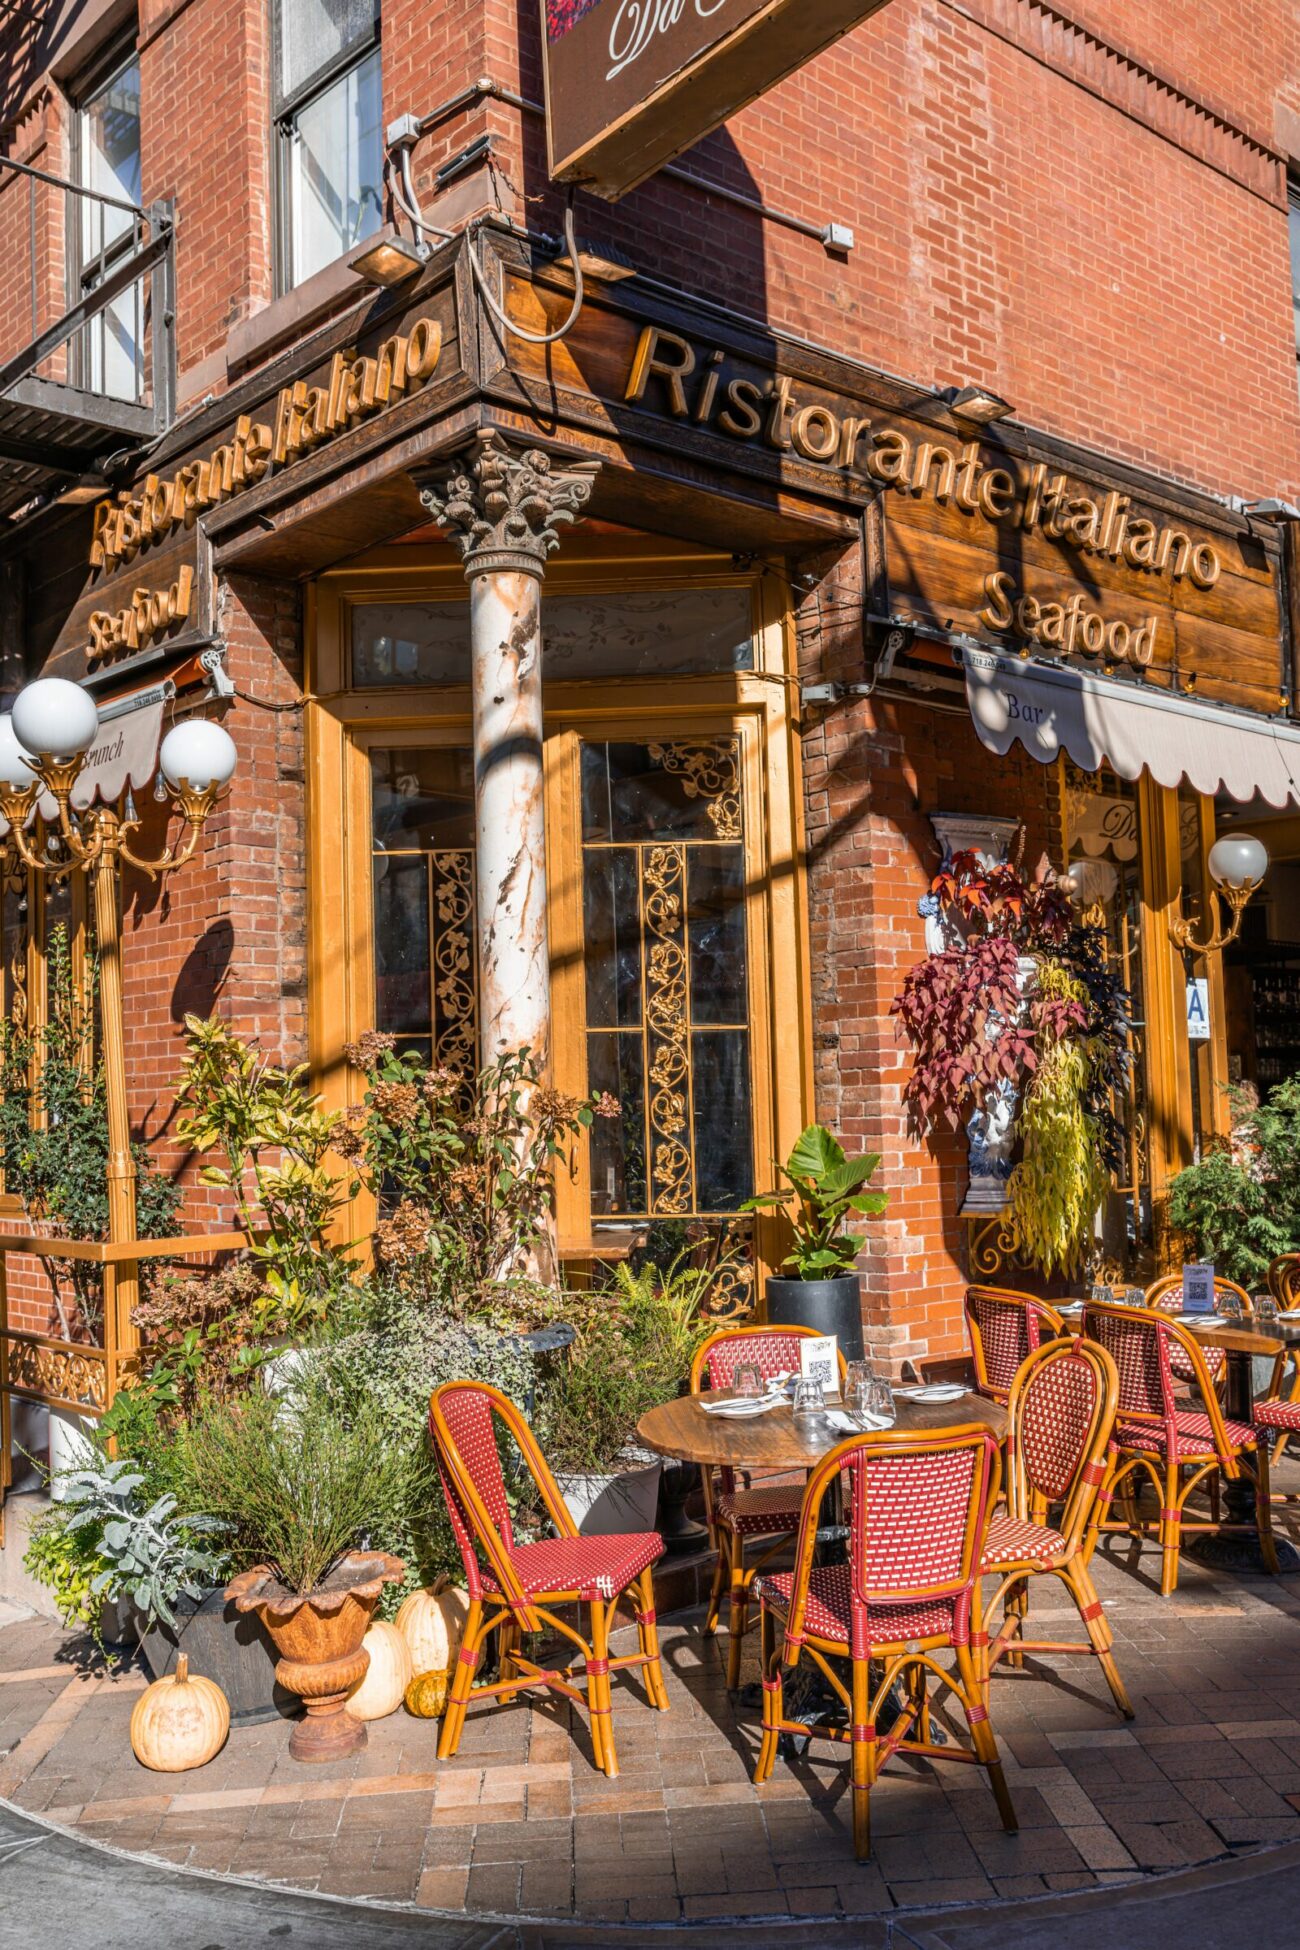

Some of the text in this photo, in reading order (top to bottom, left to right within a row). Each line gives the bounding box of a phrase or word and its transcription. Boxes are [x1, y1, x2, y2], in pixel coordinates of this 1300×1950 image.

[89, 317, 442, 567] Ristorante Italiano
[625, 326, 1221, 587] Ristorante Italiano
[85, 564, 194, 659] Seafood
[976, 571, 1158, 666] Seafood
[1006, 693, 1043, 724] Bar
[1187, 989, 1205, 1021] A
